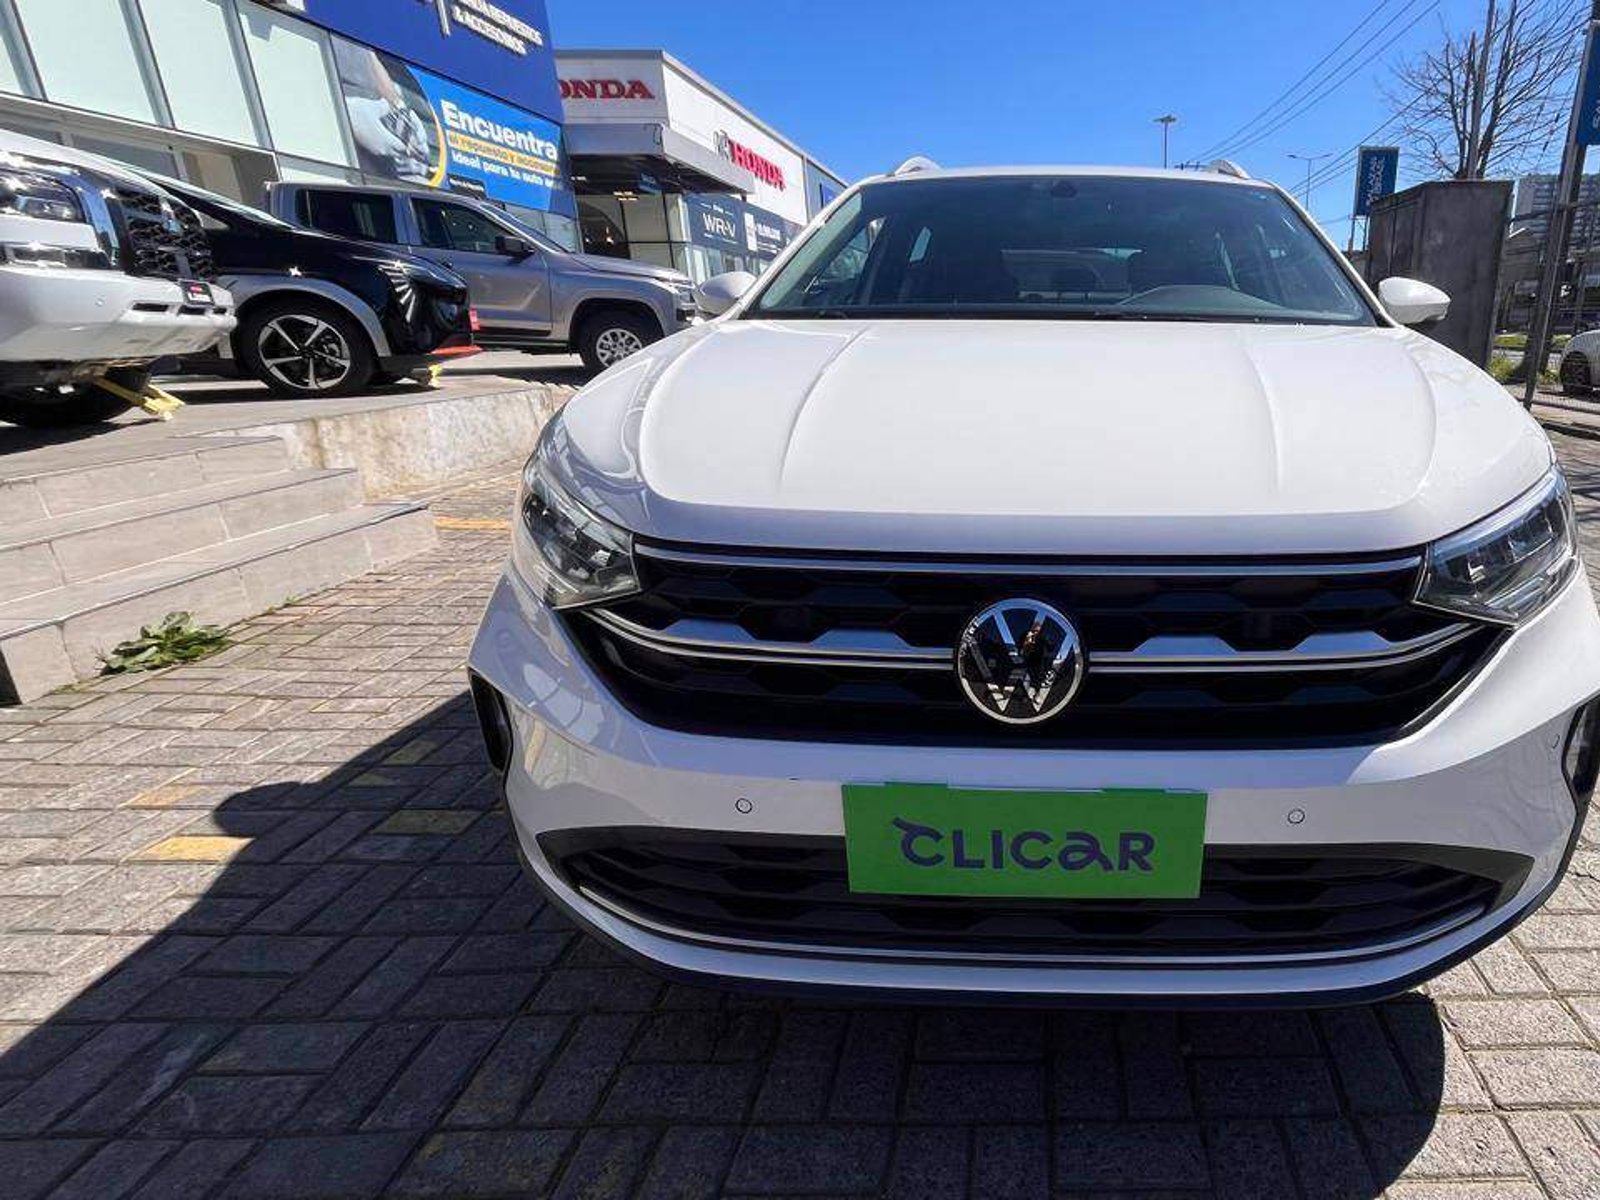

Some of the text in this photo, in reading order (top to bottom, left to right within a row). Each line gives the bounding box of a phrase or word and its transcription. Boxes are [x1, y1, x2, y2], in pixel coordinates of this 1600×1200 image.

[441, 99, 559, 161] Encuentra
[727, 139, 786, 192] HONDA
[702, 212, 736, 238] WR-V
